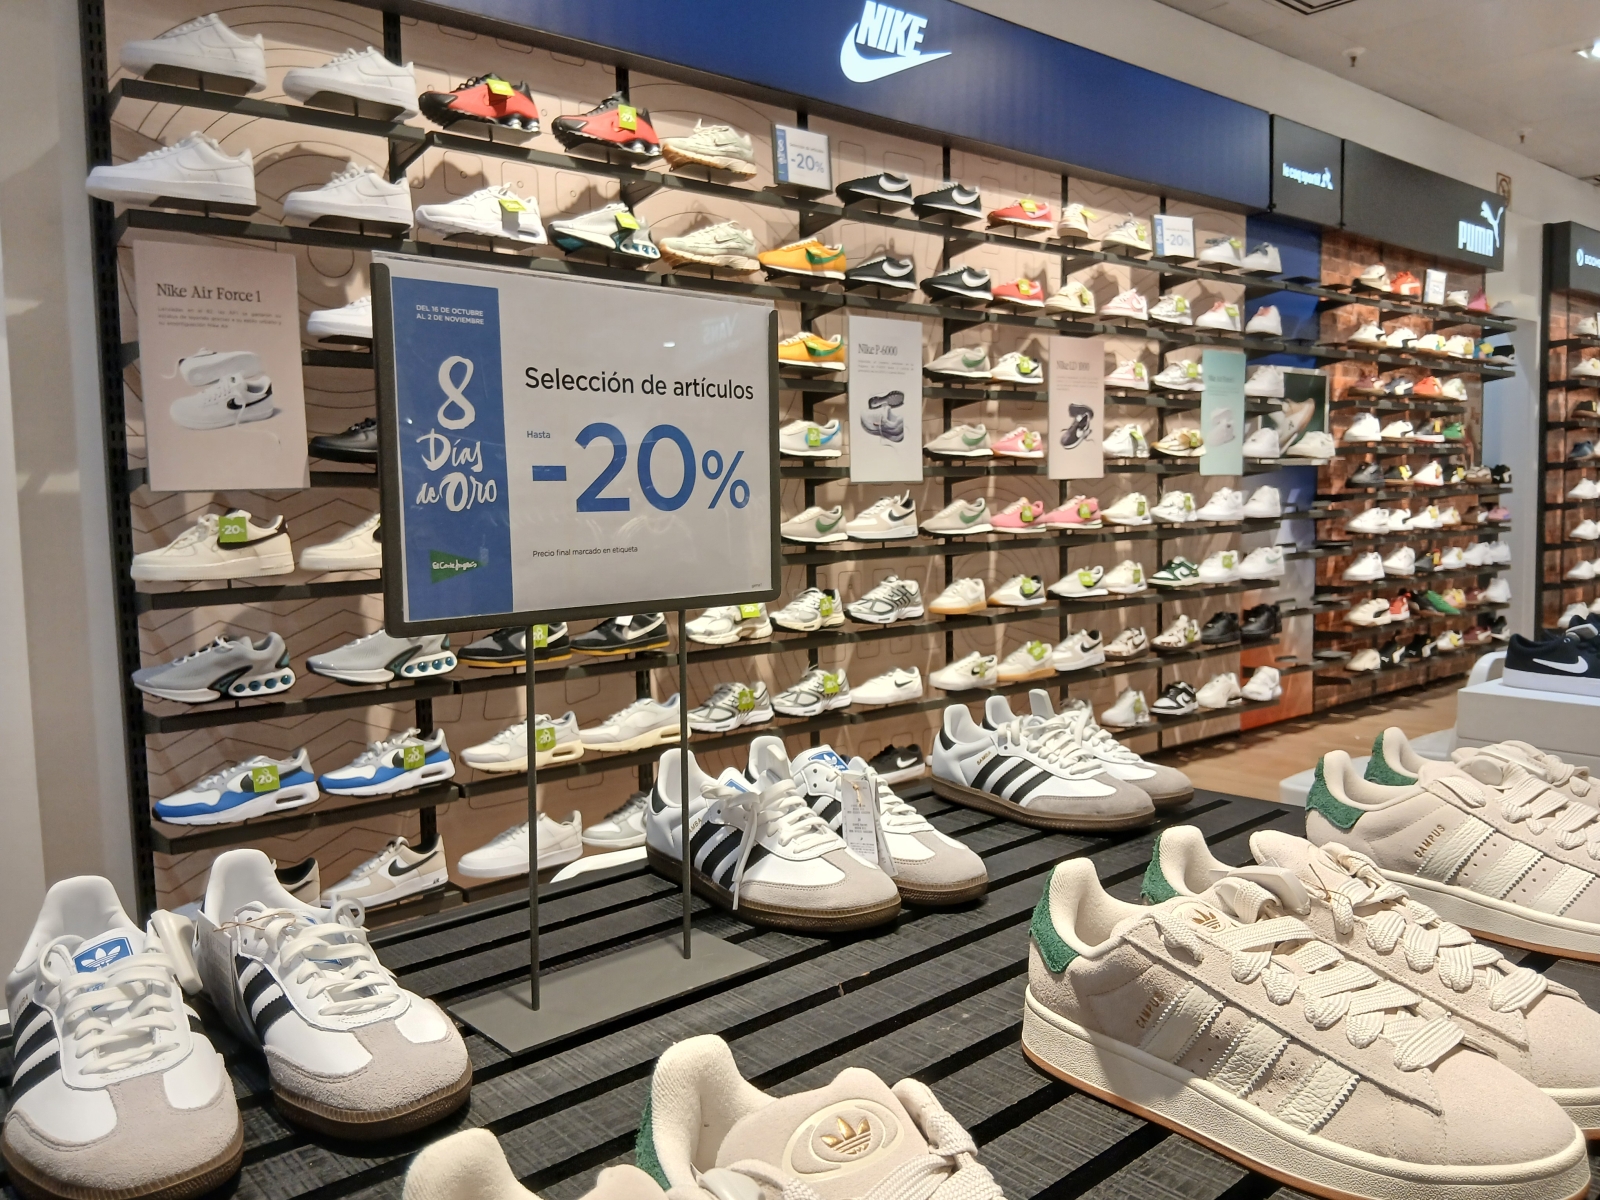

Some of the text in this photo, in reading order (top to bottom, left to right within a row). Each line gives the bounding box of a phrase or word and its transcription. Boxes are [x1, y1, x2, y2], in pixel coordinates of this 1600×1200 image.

[856, 0, 928, 57] NIKE
[791, 153, 825, 173] -20%
[1458, 220, 1494, 257] PUMA
[156, 283, 262, 303] Nike Air Force 1
[415, 304, 430, 312] DEL
[451, 307, 484, 317] OCTUBRE
[444, 315, 485, 325] NOVIEMBRE
[437, 355, 476, 430] 8
[525, 366, 754, 400] Selección de artículos
[416, 428, 483, 472] Días
[526, 430, 551, 439] Hasta
[532, 422, 751, 512] -20%
[416, 472, 498, 512] de Oro
[532, 550, 555, 558] Precio
[556, 548, 571, 556] final
[572, 547, 602, 556] marcado
[612, 546, 639, 555] etiqueta
[976, 751, 991, 765] SAMBA
[1413, 824, 1445, 858] CAMPUS
[1136, 991, 1164, 1028] CAMPUS
